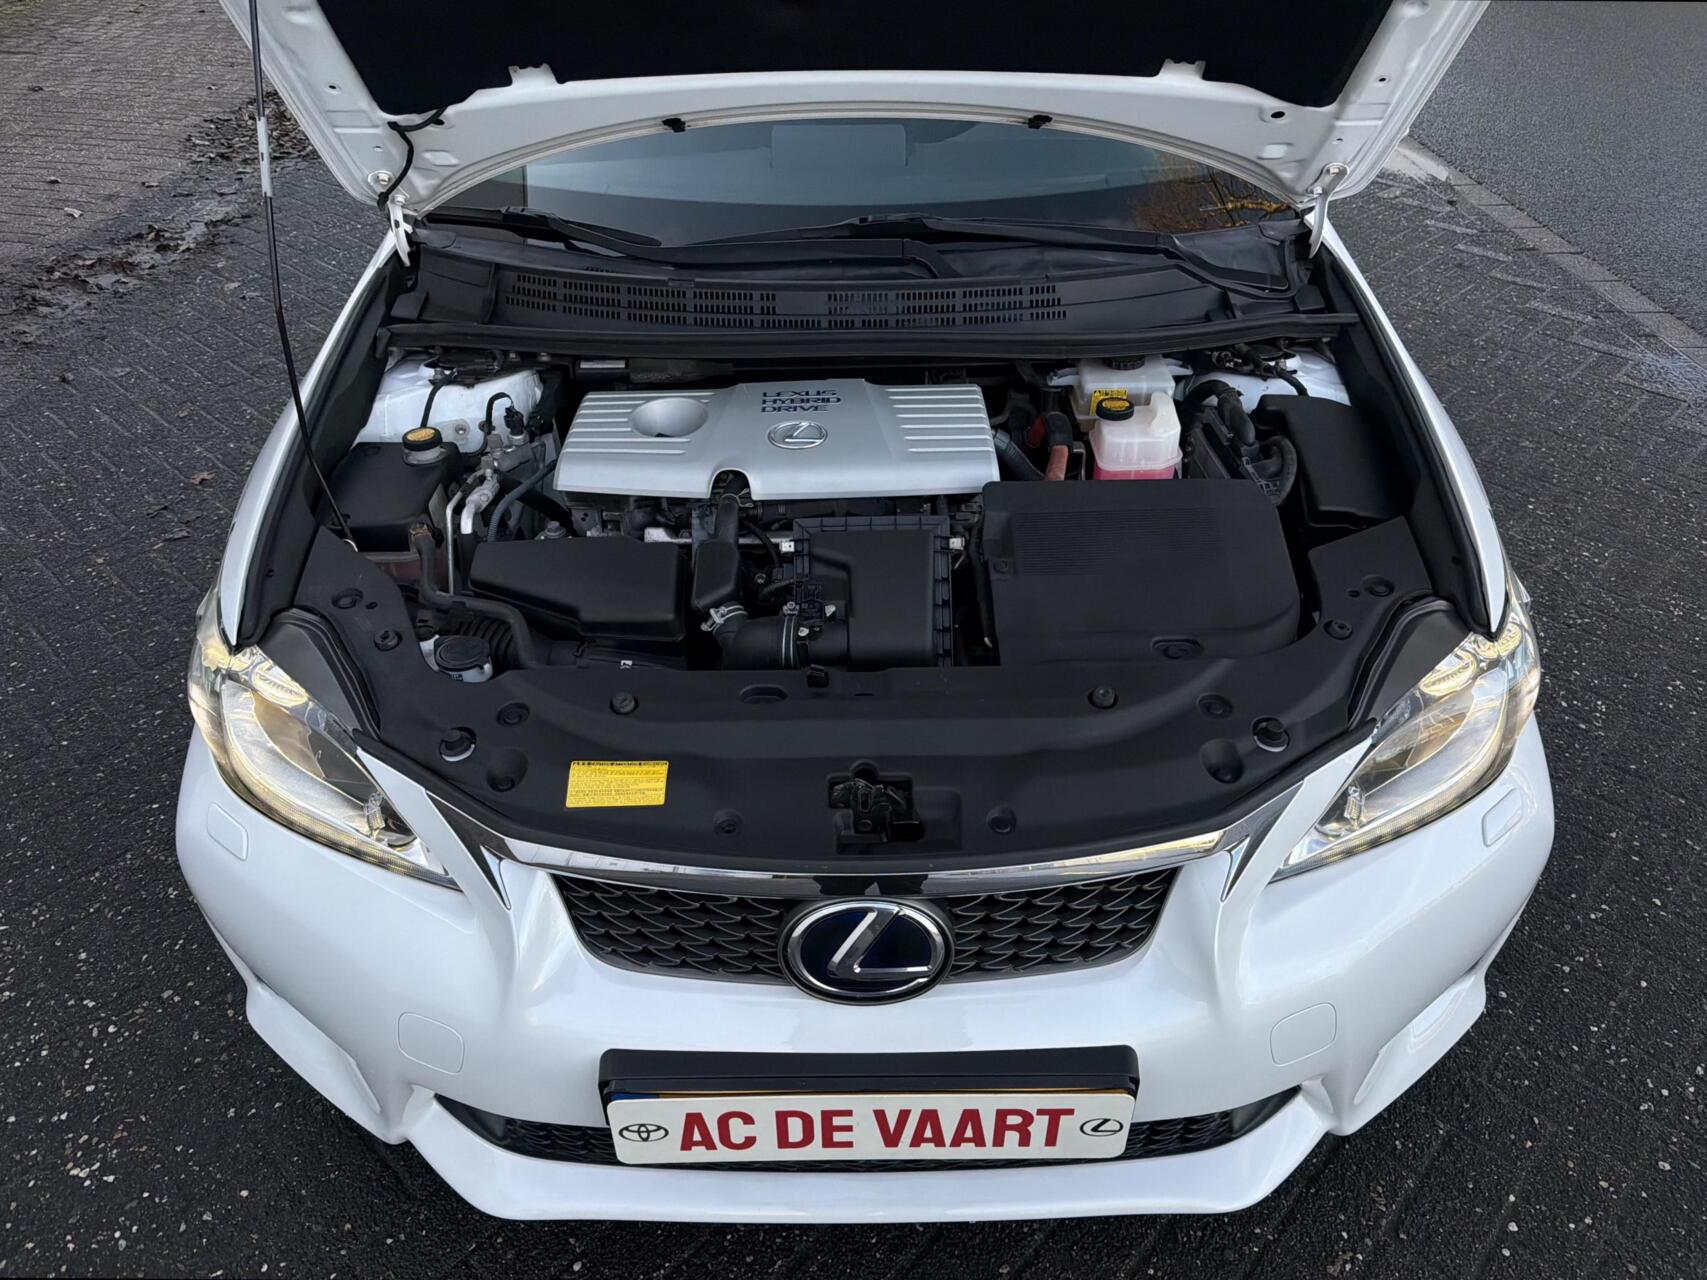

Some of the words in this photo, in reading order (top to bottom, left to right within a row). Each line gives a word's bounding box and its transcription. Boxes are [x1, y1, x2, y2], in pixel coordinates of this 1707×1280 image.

[762, 389, 837, 397] LEXUS
[761, 397, 841, 405] HYBRID
[761, 404, 829, 412] DRIVE
[679, 1110, 758, 1152] AC
[776, 1109, 854, 1150] DE
[873, 1108, 1075, 1149] VAART
